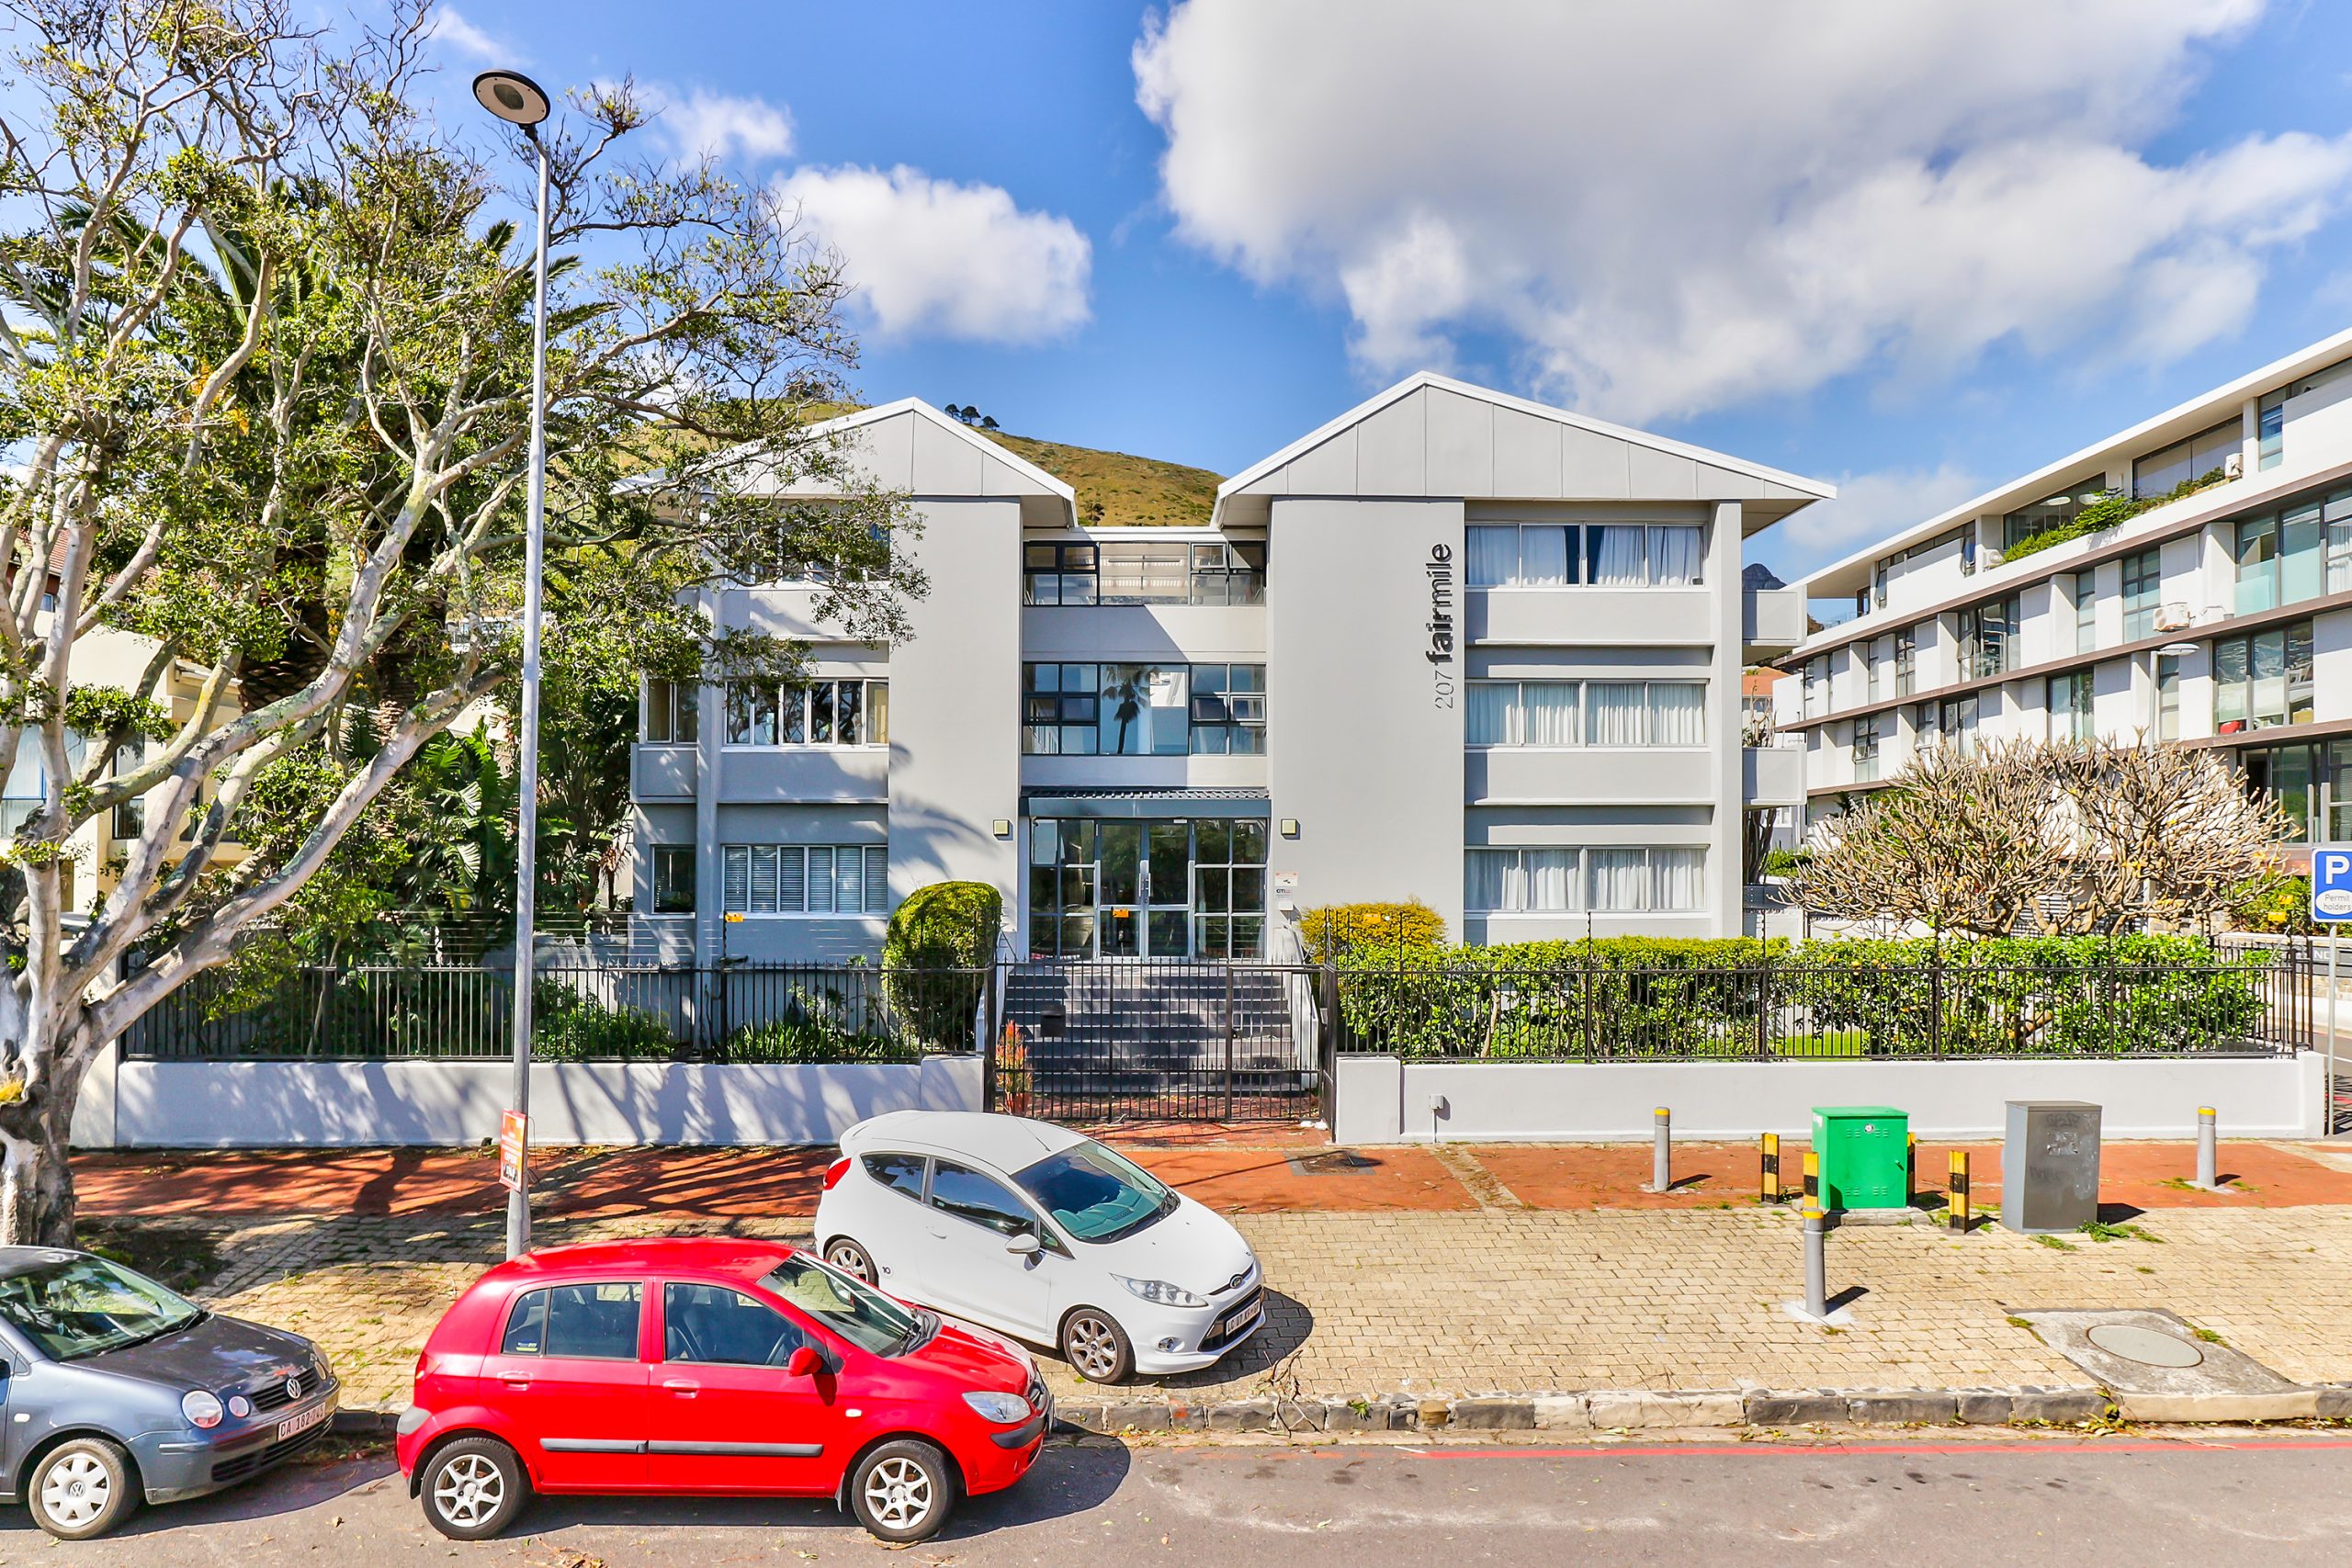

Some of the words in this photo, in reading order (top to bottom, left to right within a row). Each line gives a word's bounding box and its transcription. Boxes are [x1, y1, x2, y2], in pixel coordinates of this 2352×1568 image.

[1426, 544, 1453, 666] fairmile
[1434, 671, 1453, 709] 207
[2325, 855, 2350, 885] P
[2324, 894, 2350, 902] Permit
[2324, 903, 2352, 911] holders
[882, 1266, 891, 1275] 10
[280, 1421, 291, 1438] CA
